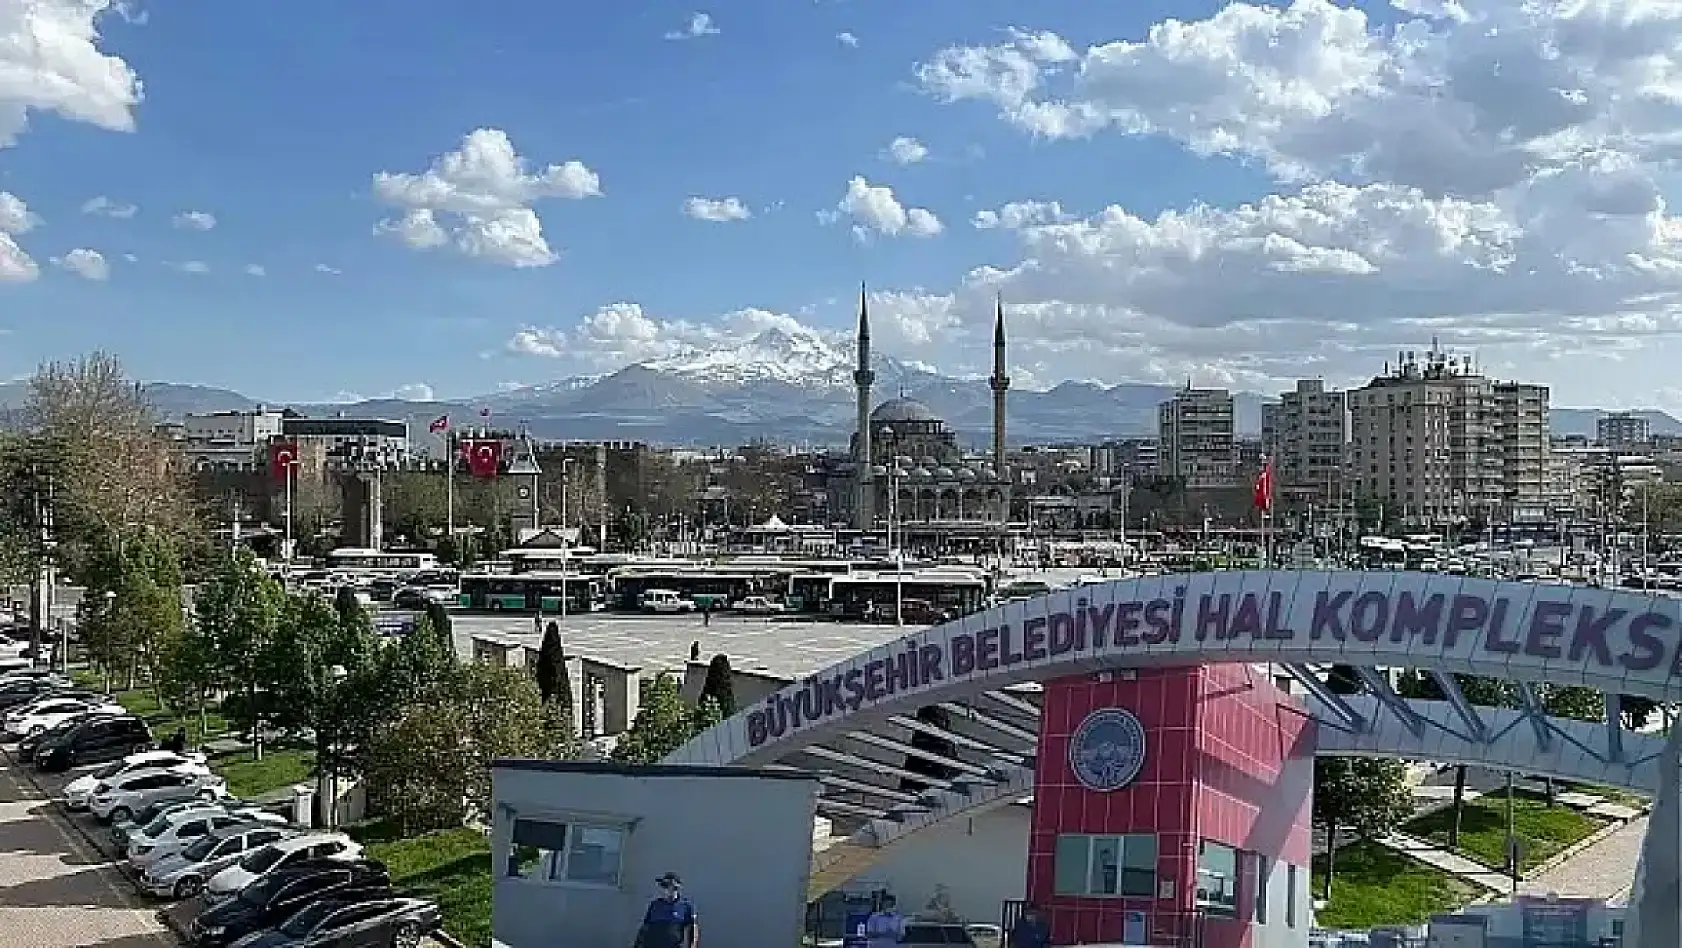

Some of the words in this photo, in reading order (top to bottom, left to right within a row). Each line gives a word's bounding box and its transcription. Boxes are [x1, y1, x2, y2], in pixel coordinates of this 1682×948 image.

[747, 639, 945, 747] BÜYÜKŞEHİR
[951, 585, 1187, 675] BELEDİYESİ
[1194, 592, 1295, 641] HAL
